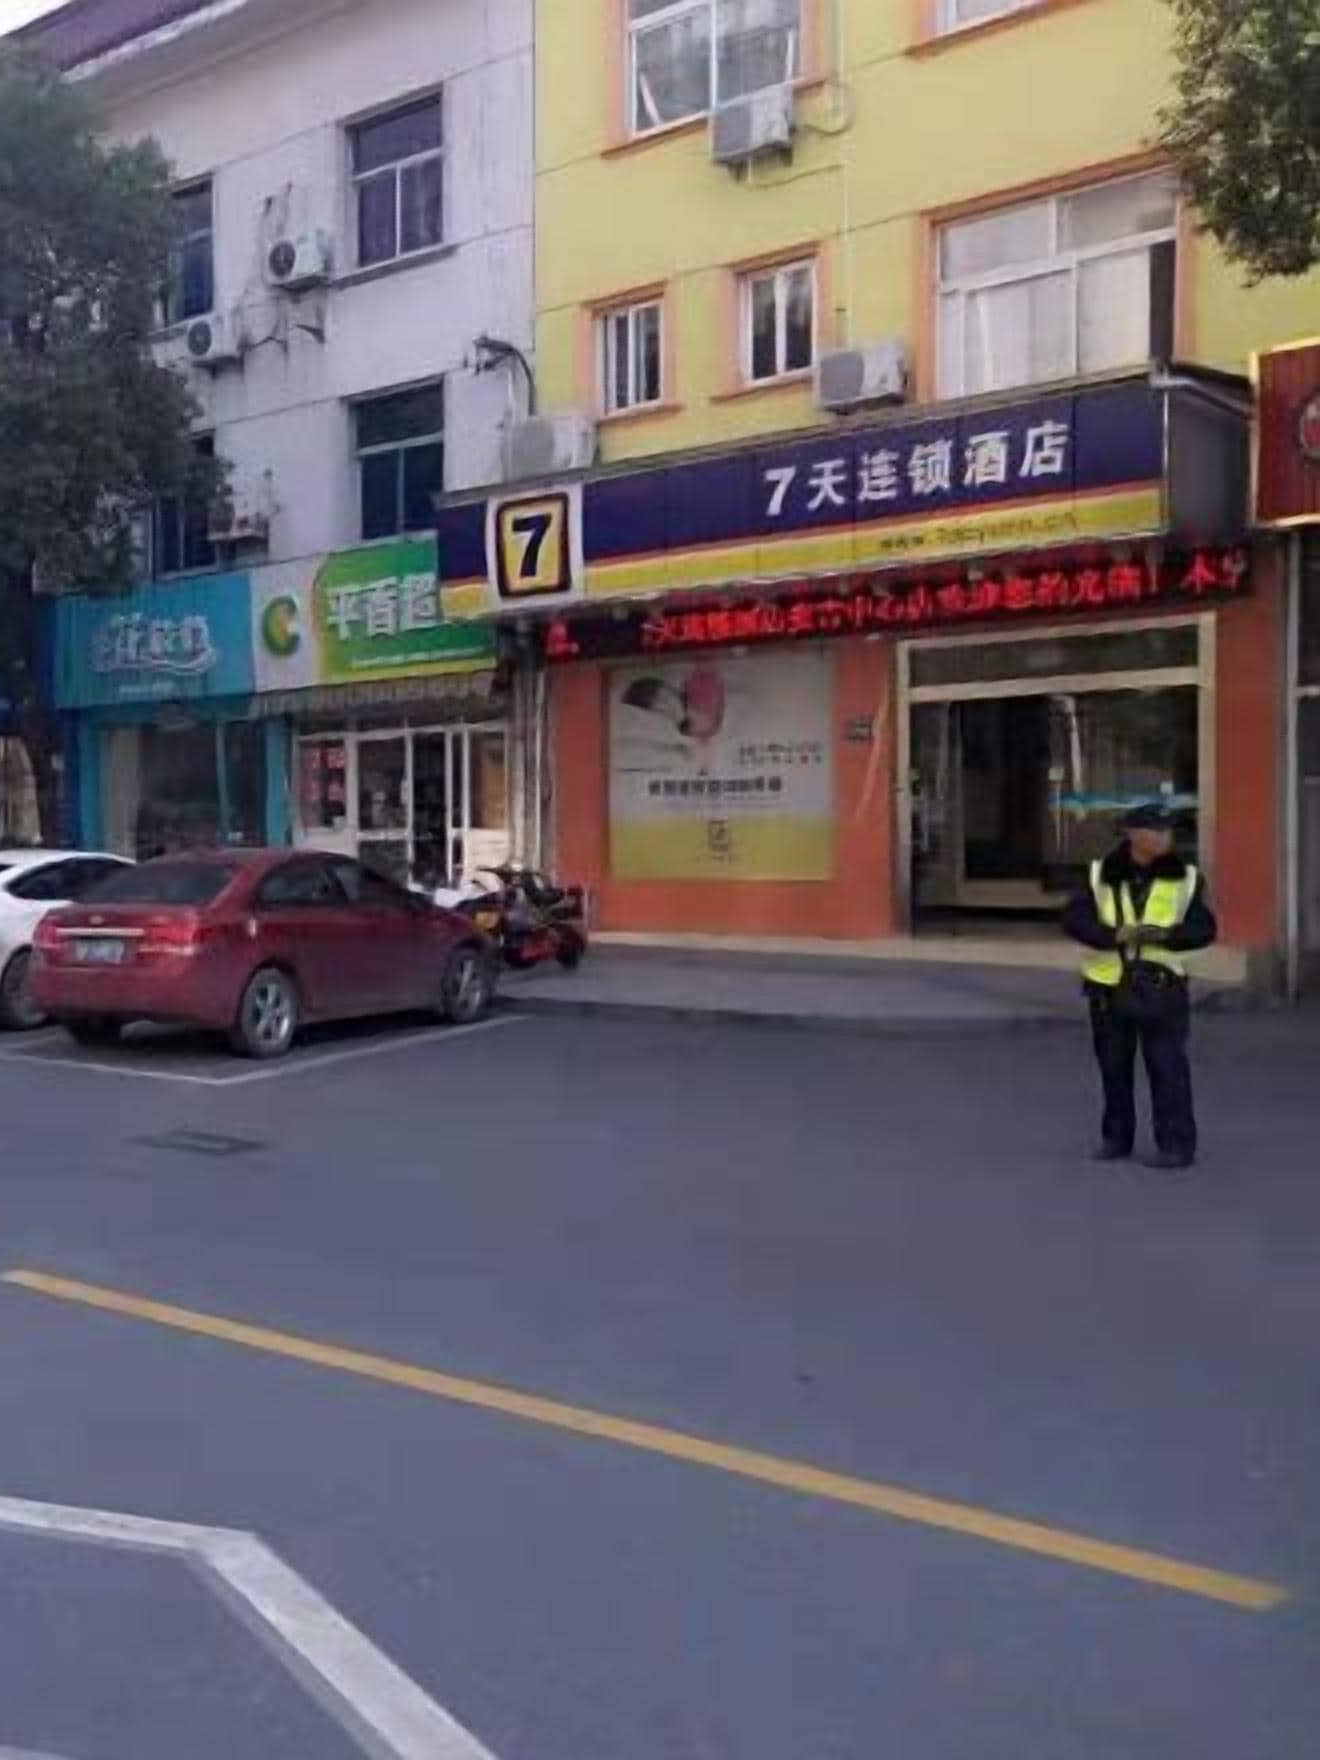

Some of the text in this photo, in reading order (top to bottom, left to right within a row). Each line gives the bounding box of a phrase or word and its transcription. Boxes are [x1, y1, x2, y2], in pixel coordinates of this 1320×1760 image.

[764, 420, 1069, 517] 7天连锁酒店
[511, 512, 553, 578] 7
